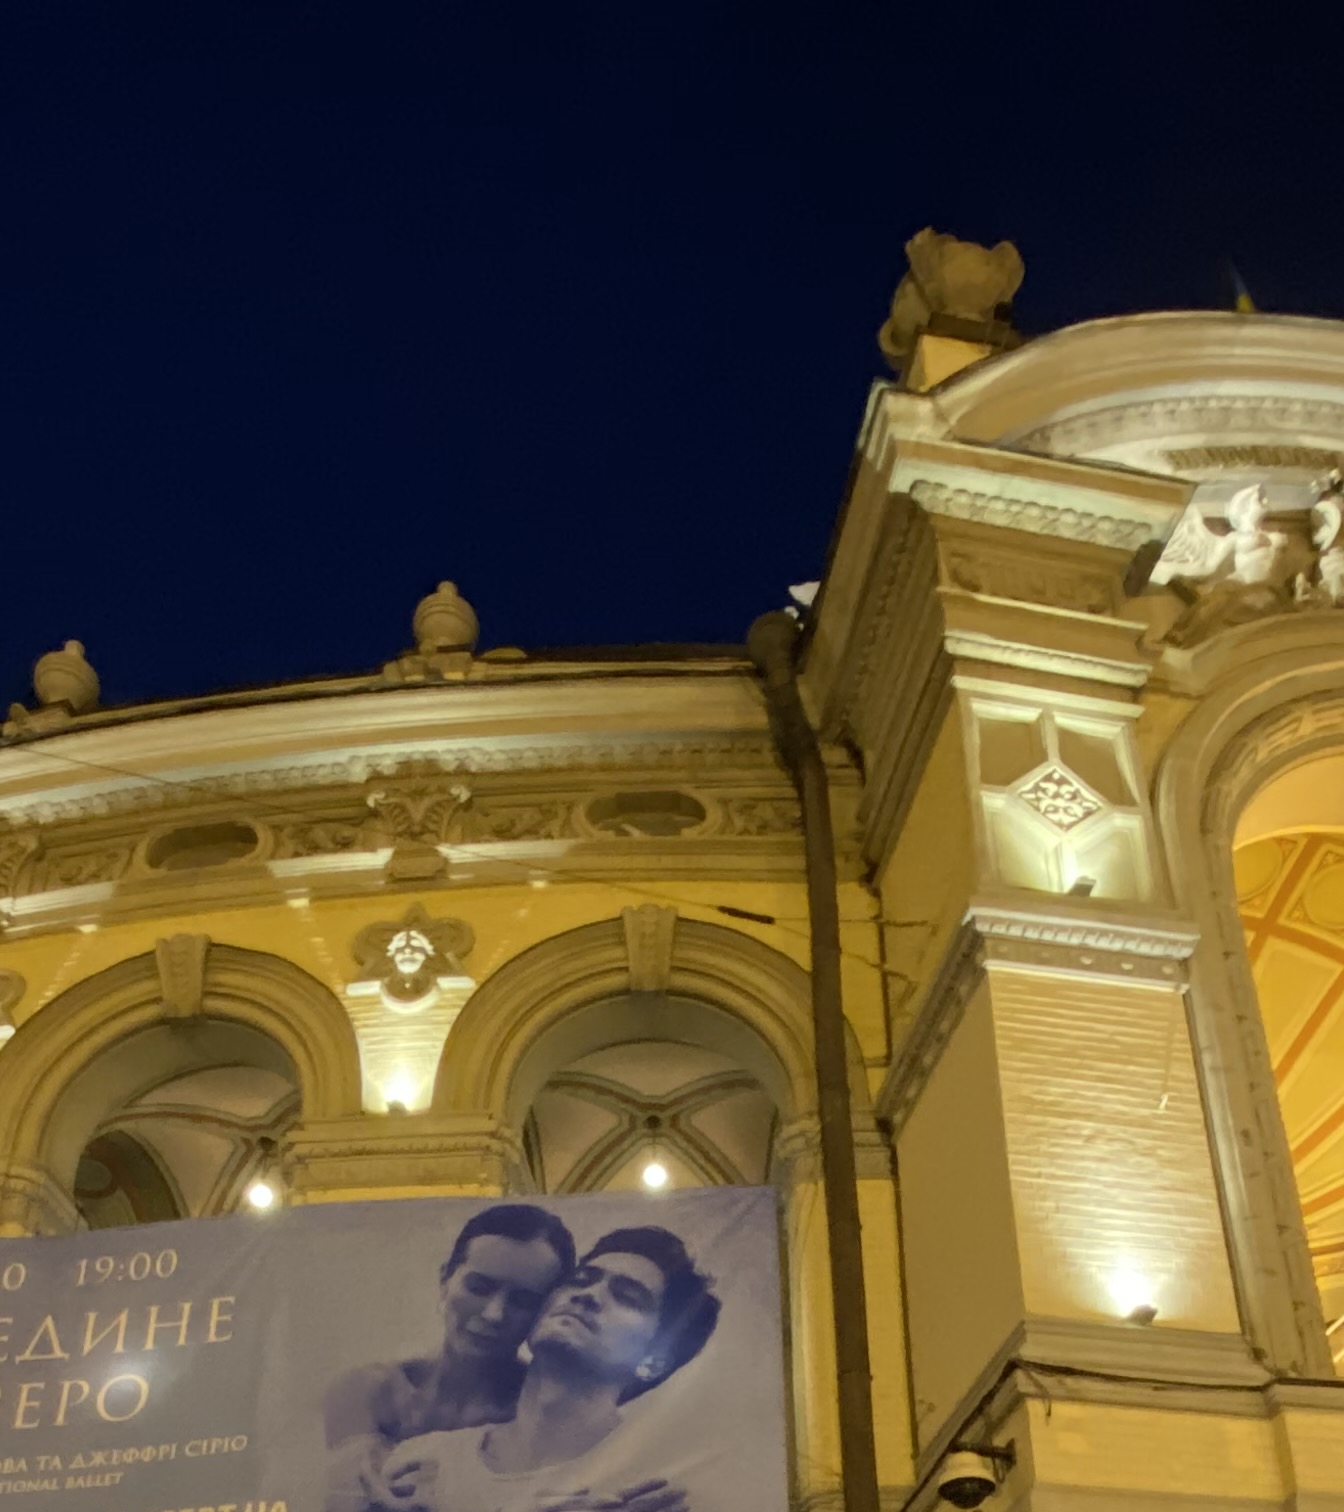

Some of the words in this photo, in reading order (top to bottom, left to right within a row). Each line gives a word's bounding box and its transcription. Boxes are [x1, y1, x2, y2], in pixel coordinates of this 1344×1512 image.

[74, 1248, 179, 1287] 19:00
[36, 1455, 63, 1472] ТА
[68, 1442, 179, 1470] ДЖЕФФРІ
[65, 1471, 125, 1490] BALLET
